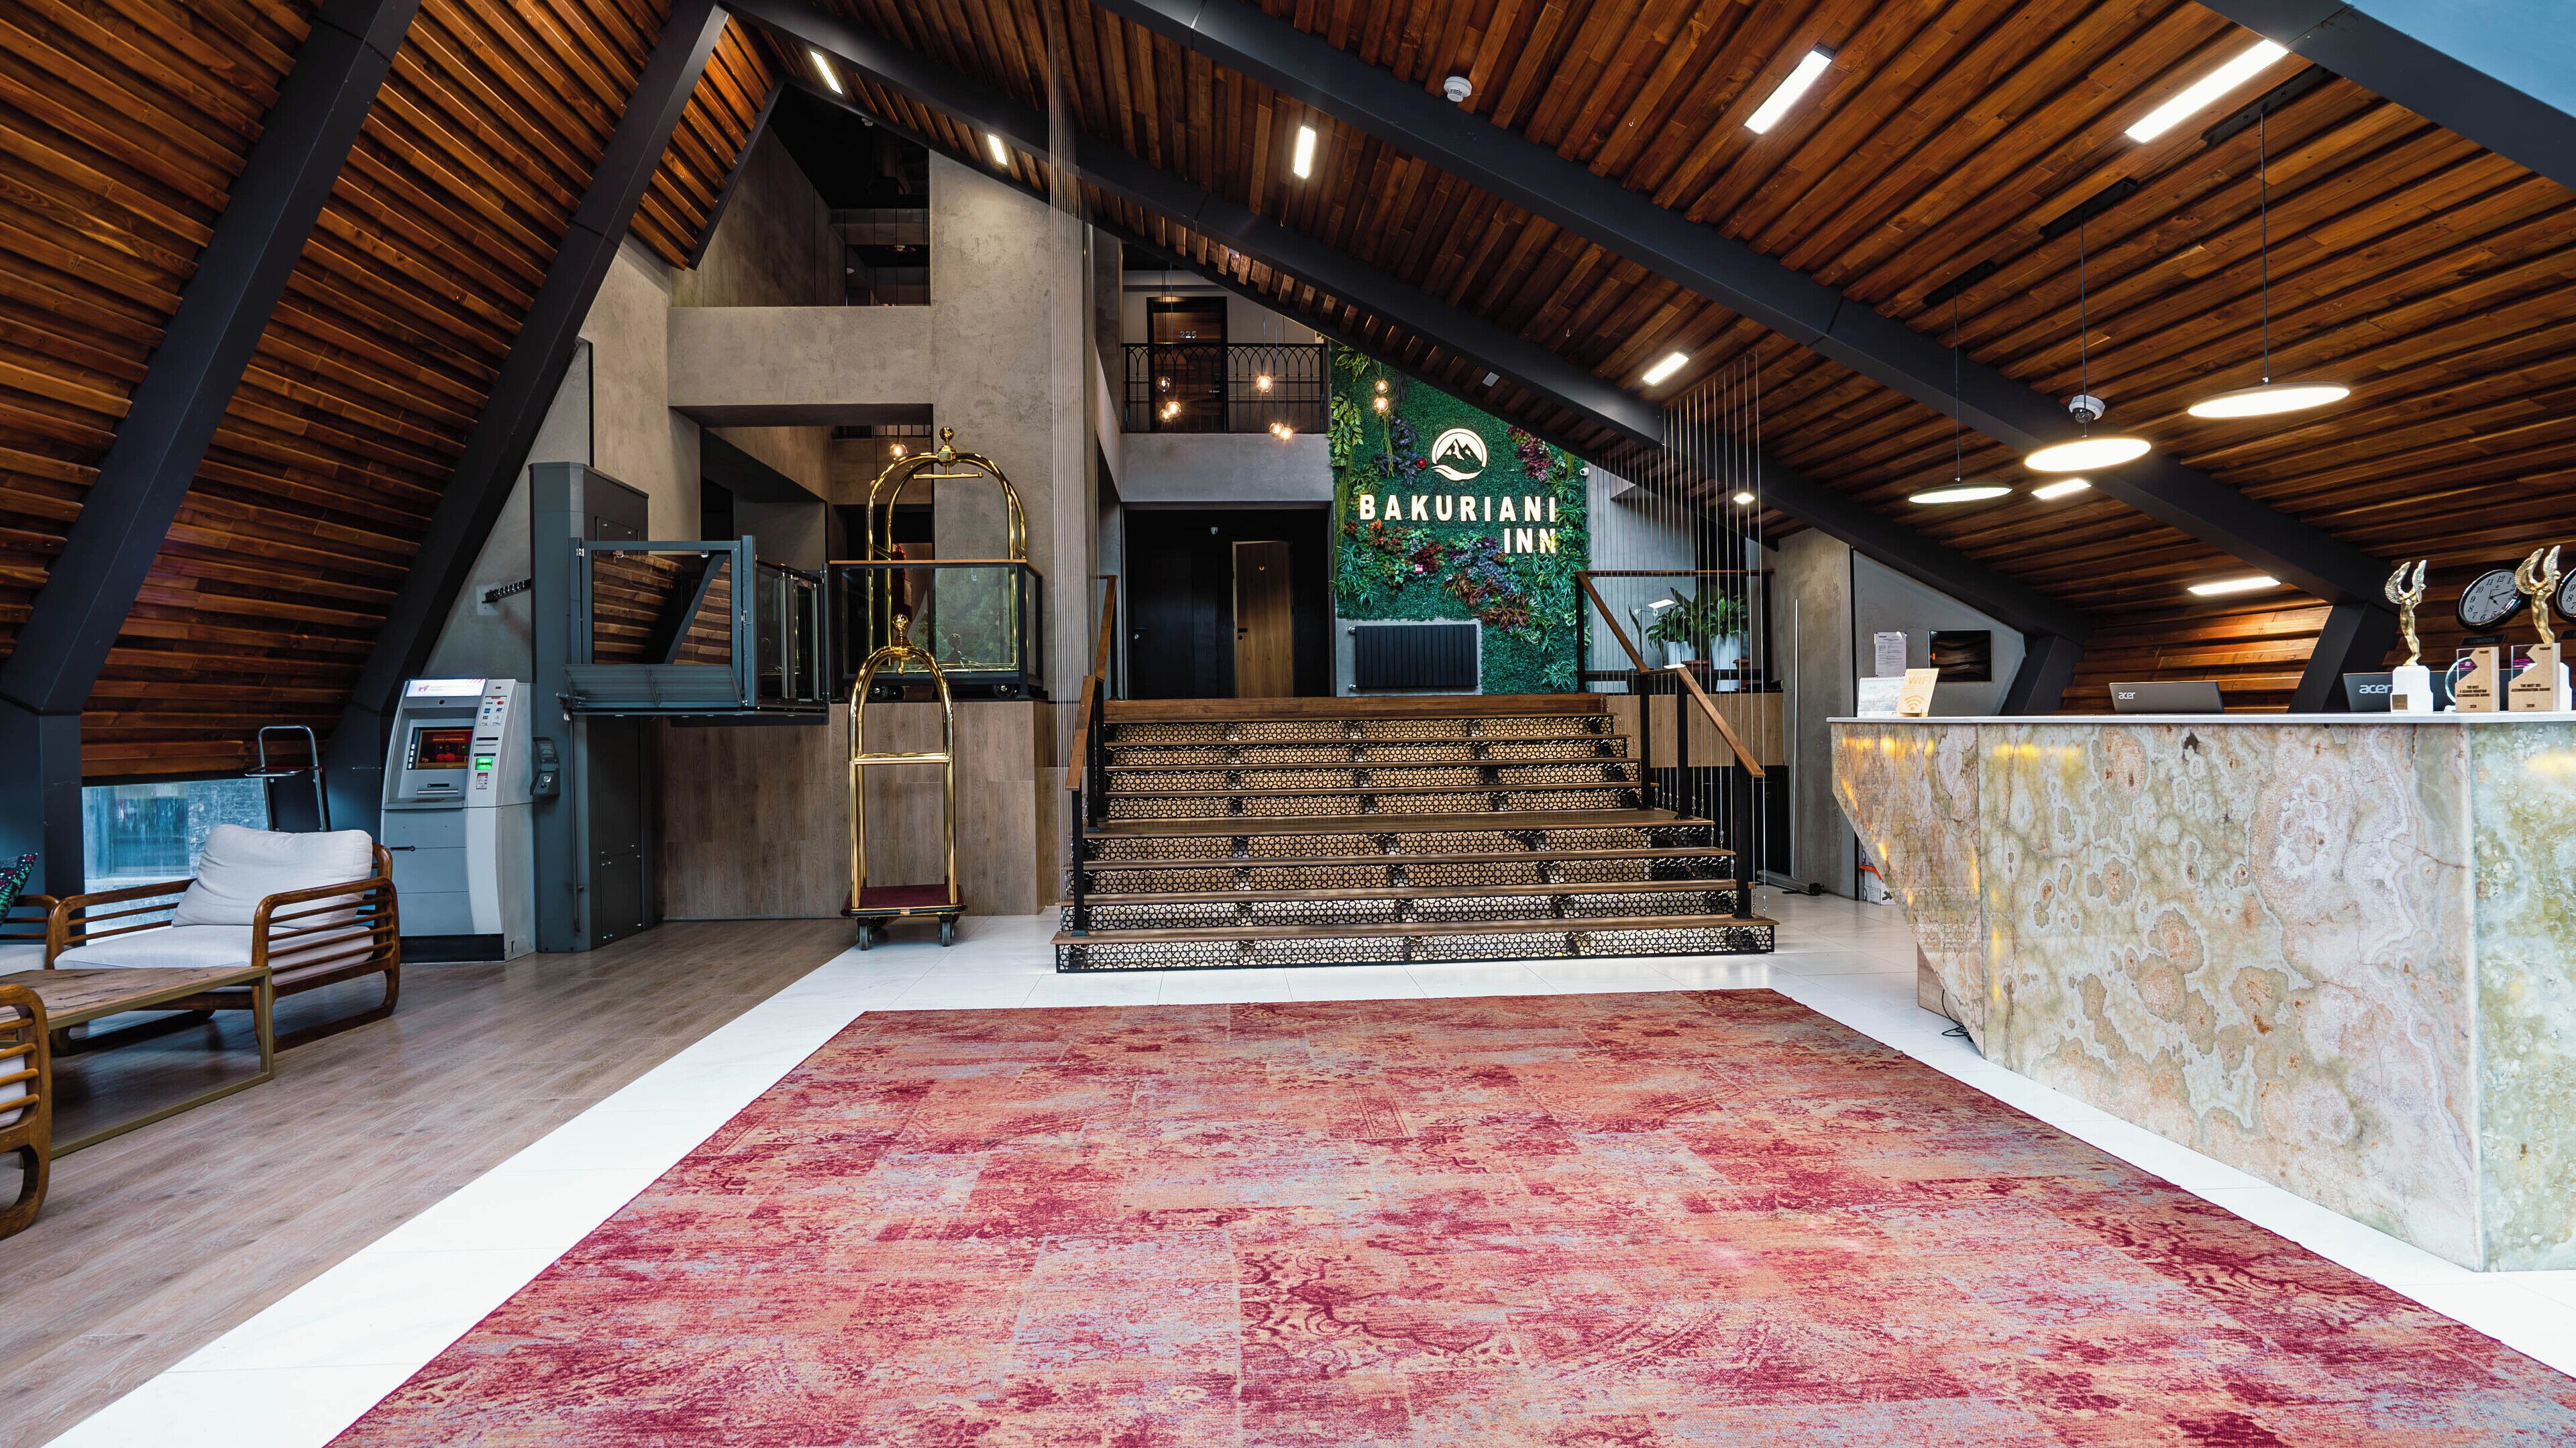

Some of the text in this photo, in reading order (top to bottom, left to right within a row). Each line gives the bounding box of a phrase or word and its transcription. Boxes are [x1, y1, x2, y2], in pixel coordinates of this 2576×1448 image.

[1180, 331, 1197, 339] 225
[1359, 494, 1556, 522] BAKURIANI
[1504, 528, 1556, 553] INN
[2359, 684, 2392, 693] acer
